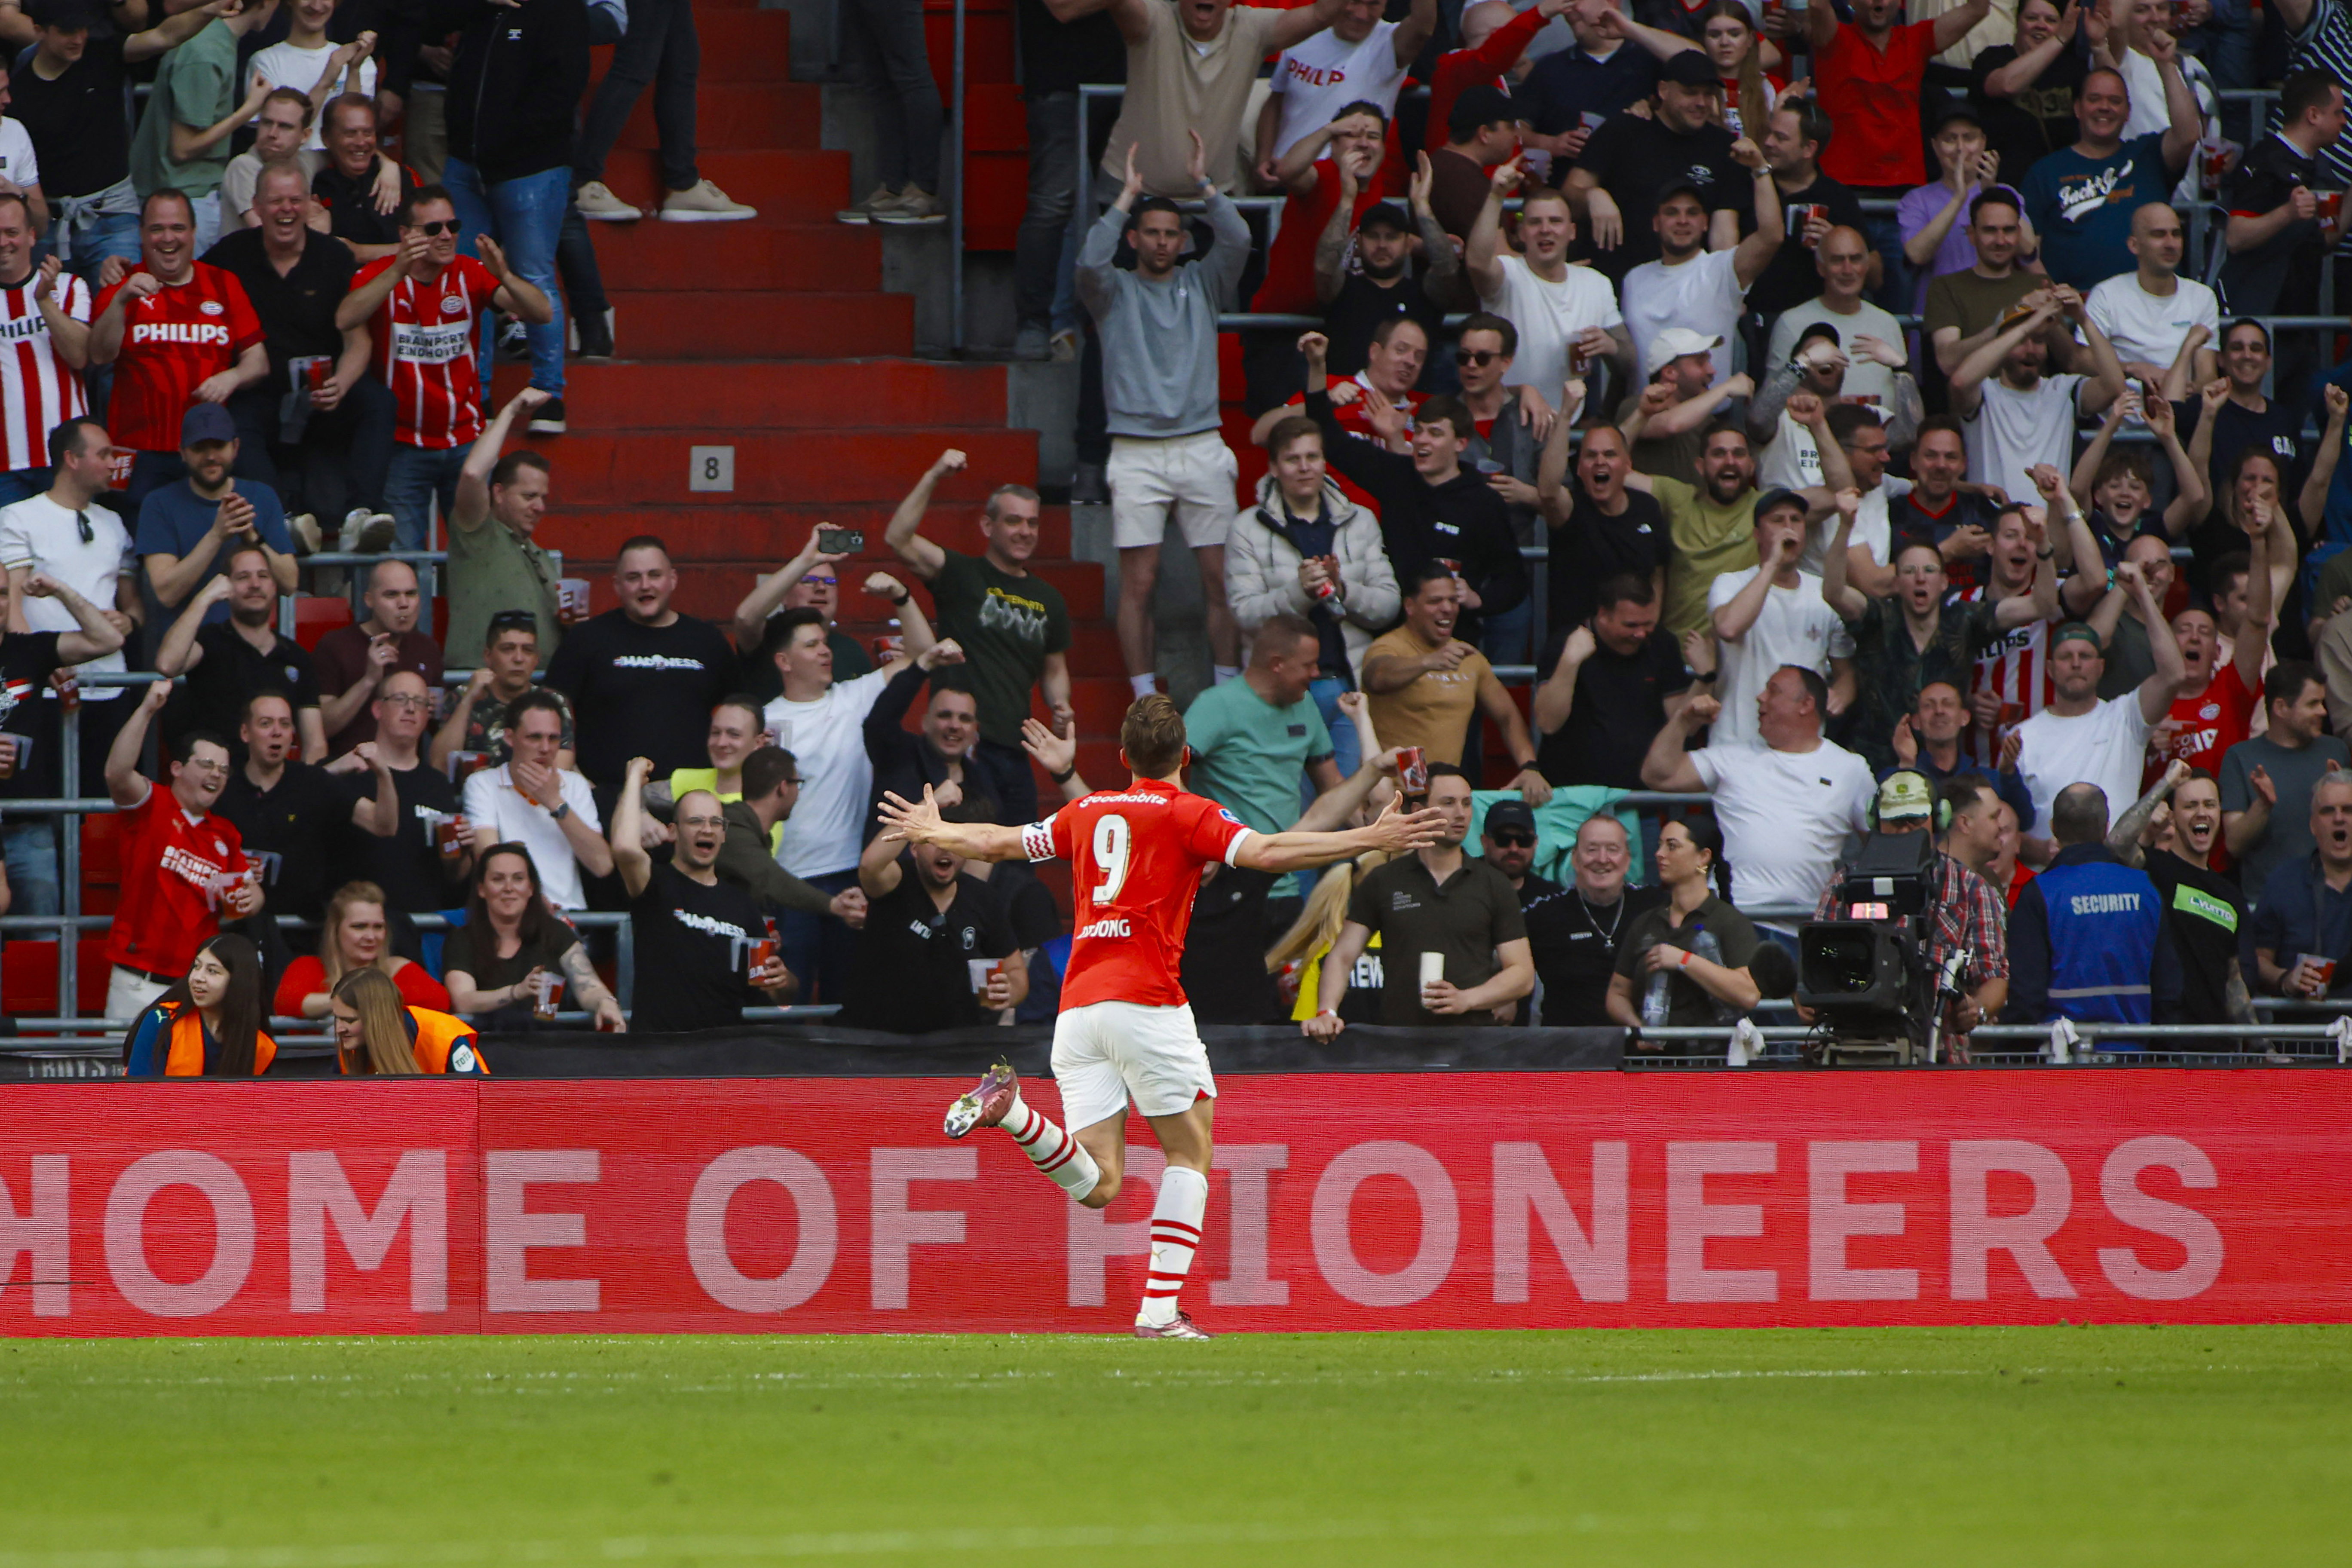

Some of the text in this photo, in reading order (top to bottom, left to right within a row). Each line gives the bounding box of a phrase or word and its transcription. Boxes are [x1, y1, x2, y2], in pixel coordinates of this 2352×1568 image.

[133, 323, 230, 346] PHILIPS
[398, 332, 465, 346] BRAINPORT
[705, 456, 719, 479] 8
[1079, 793, 1168, 808] goodhabitz
[1092, 814, 1132, 906] 9
[2071, 893, 2140, 915] SECURITY
[1090, 919, 1131, 938] JONG
[686, 1145, 978, 1314] OF
[1067, 1136, 2225, 1308] PIONEERS
